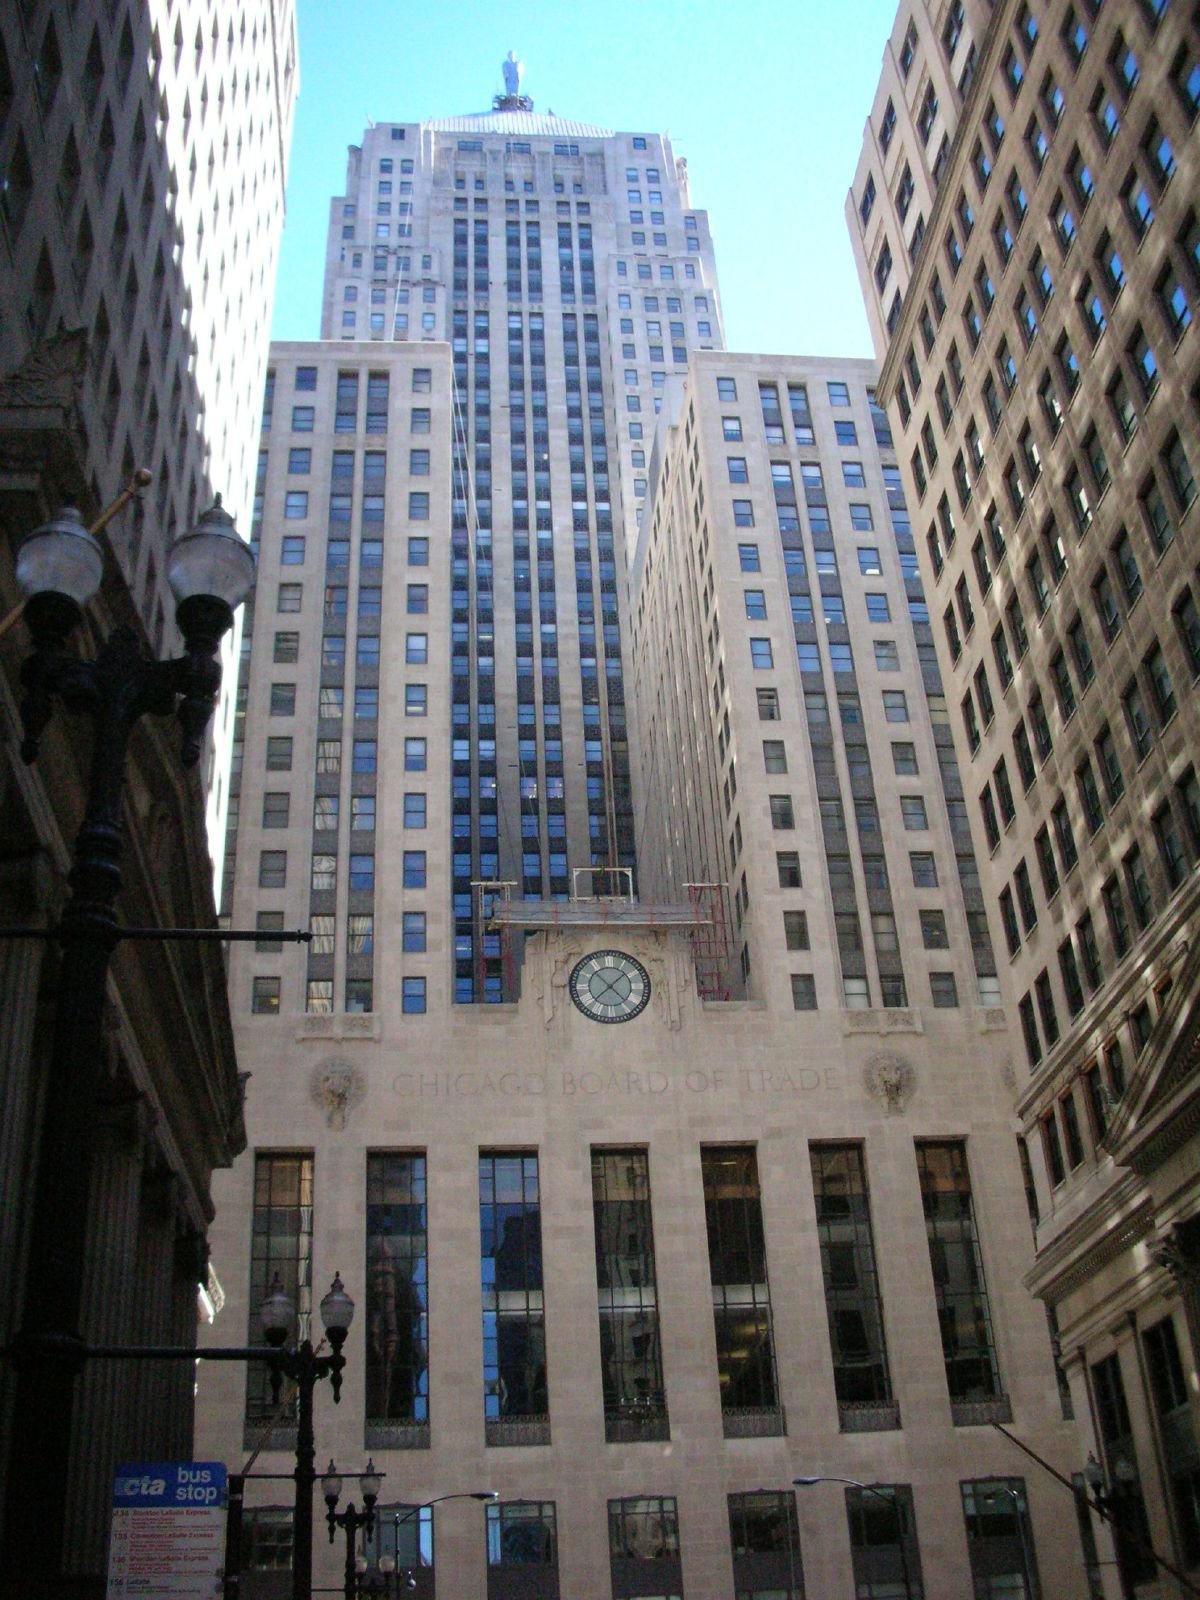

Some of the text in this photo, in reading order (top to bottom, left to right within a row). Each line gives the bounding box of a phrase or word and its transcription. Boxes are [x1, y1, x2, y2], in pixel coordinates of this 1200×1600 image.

[392, 1068, 841, 1096] CHICAGO BOARD OF TRADE
[178, 1466, 211, 1483] bus
[123, 1475, 166, 1495] cta
[176, 1484, 218, 1504] stop
